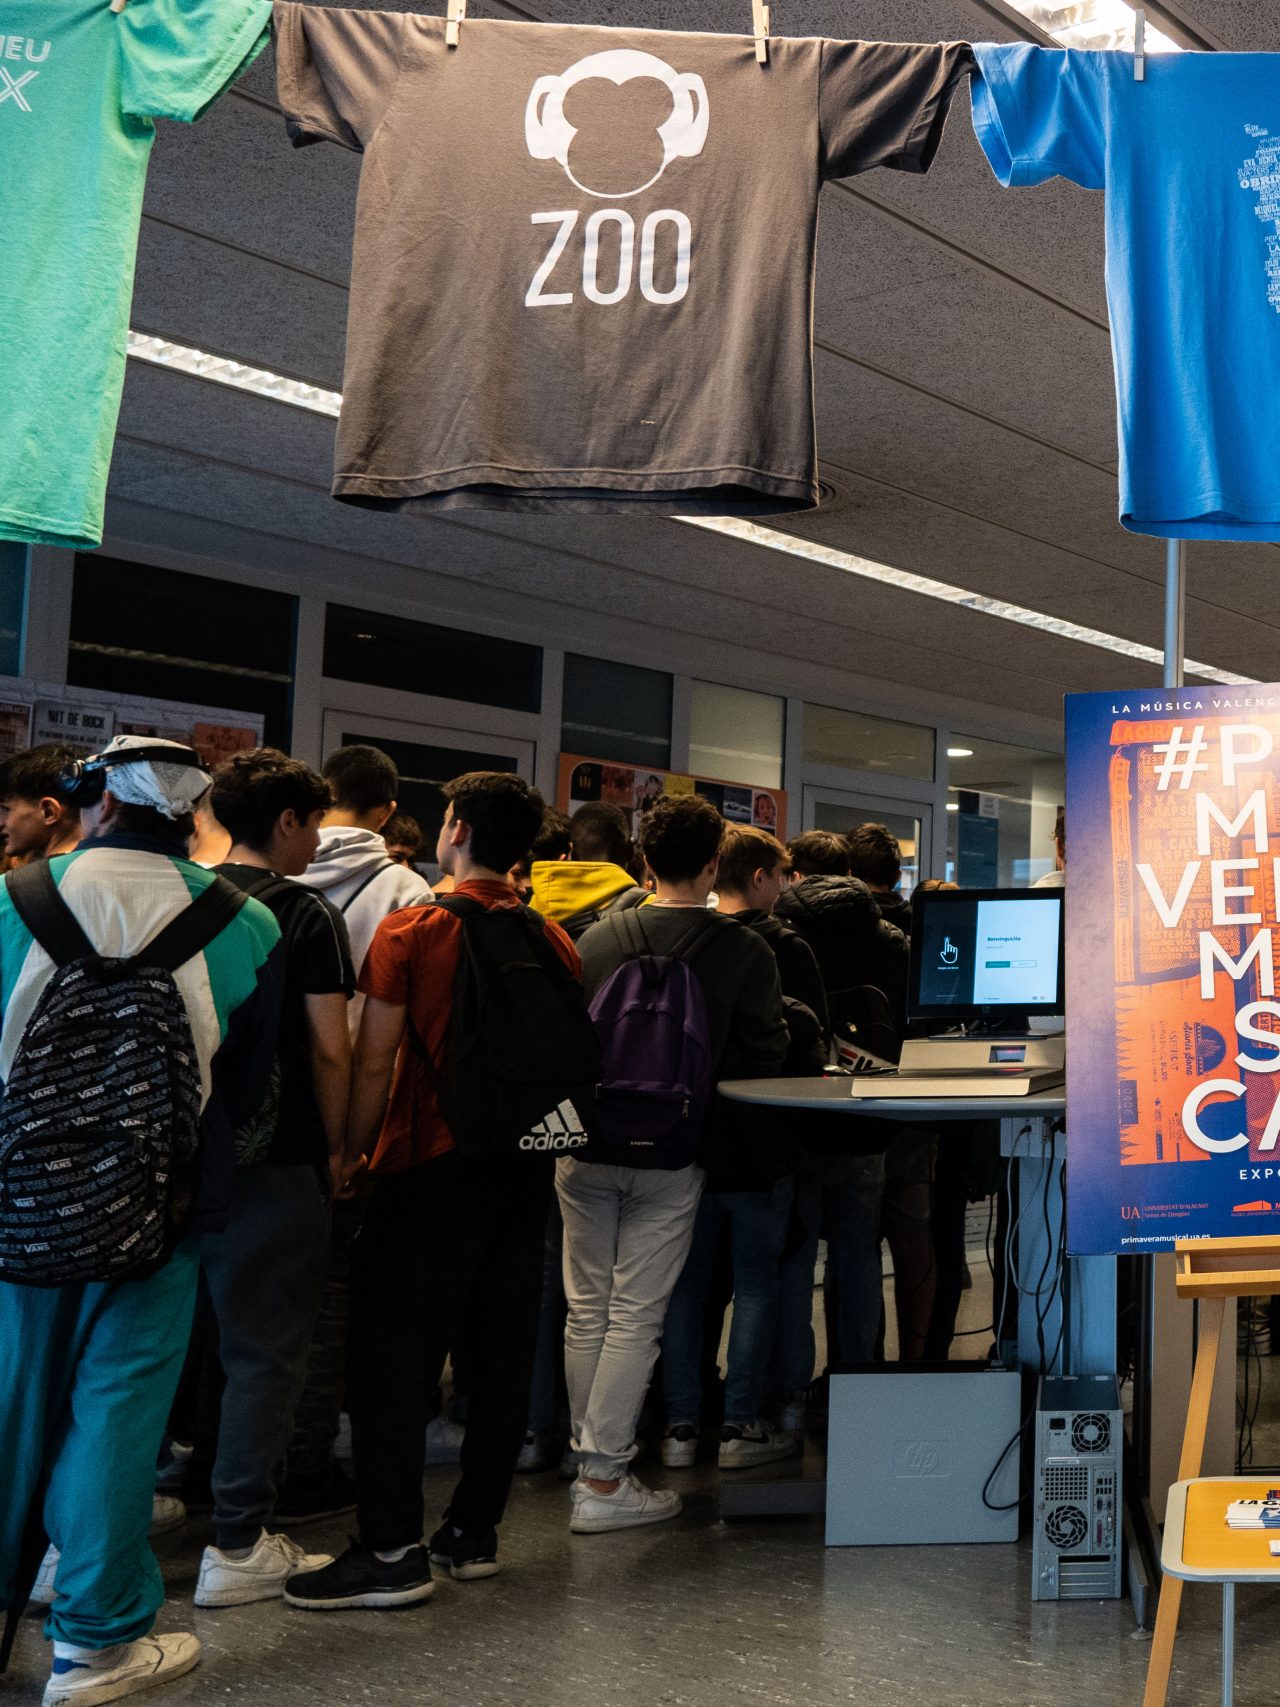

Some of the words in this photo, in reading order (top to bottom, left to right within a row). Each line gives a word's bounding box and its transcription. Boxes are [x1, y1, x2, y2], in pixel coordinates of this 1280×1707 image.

[525, 208, 692, 307] ZOO
[1112, 705, 1131, 714] LA
[1141, 701, 1203, 712] MÚSICA
[49, 709, 64, 725] NIT
[68, 712, 79, 727] DE
[82, 714, 105, 730] ROCK
[66, 1004, 95, 1018] VANS
[113, 1004, 139, 1018] VANS
[26, 1043, 53, 1059] VANS
[69, 1044, 97, 1060] VANS
[114, 1039, 139, 1056] VANS
[28, 1085, 57, 1100] VANS
[76, 1084, 105, 1099] VANS
[123, 1081, 151, 1096] VANS
[518, 1132, 589, 1151] adidas
[44, 1158, 73, 1171] VANS
[92, 1155, 119, 1173] VANS
[56, 1203, 85, 1217] VANS
[105, 1194, 131, 1214] VANS
[1121, 1206, 1140, 1219] UA
[24, 1242, 50, 1253] VANS
[118, 1230, 142, 1250] VANS
